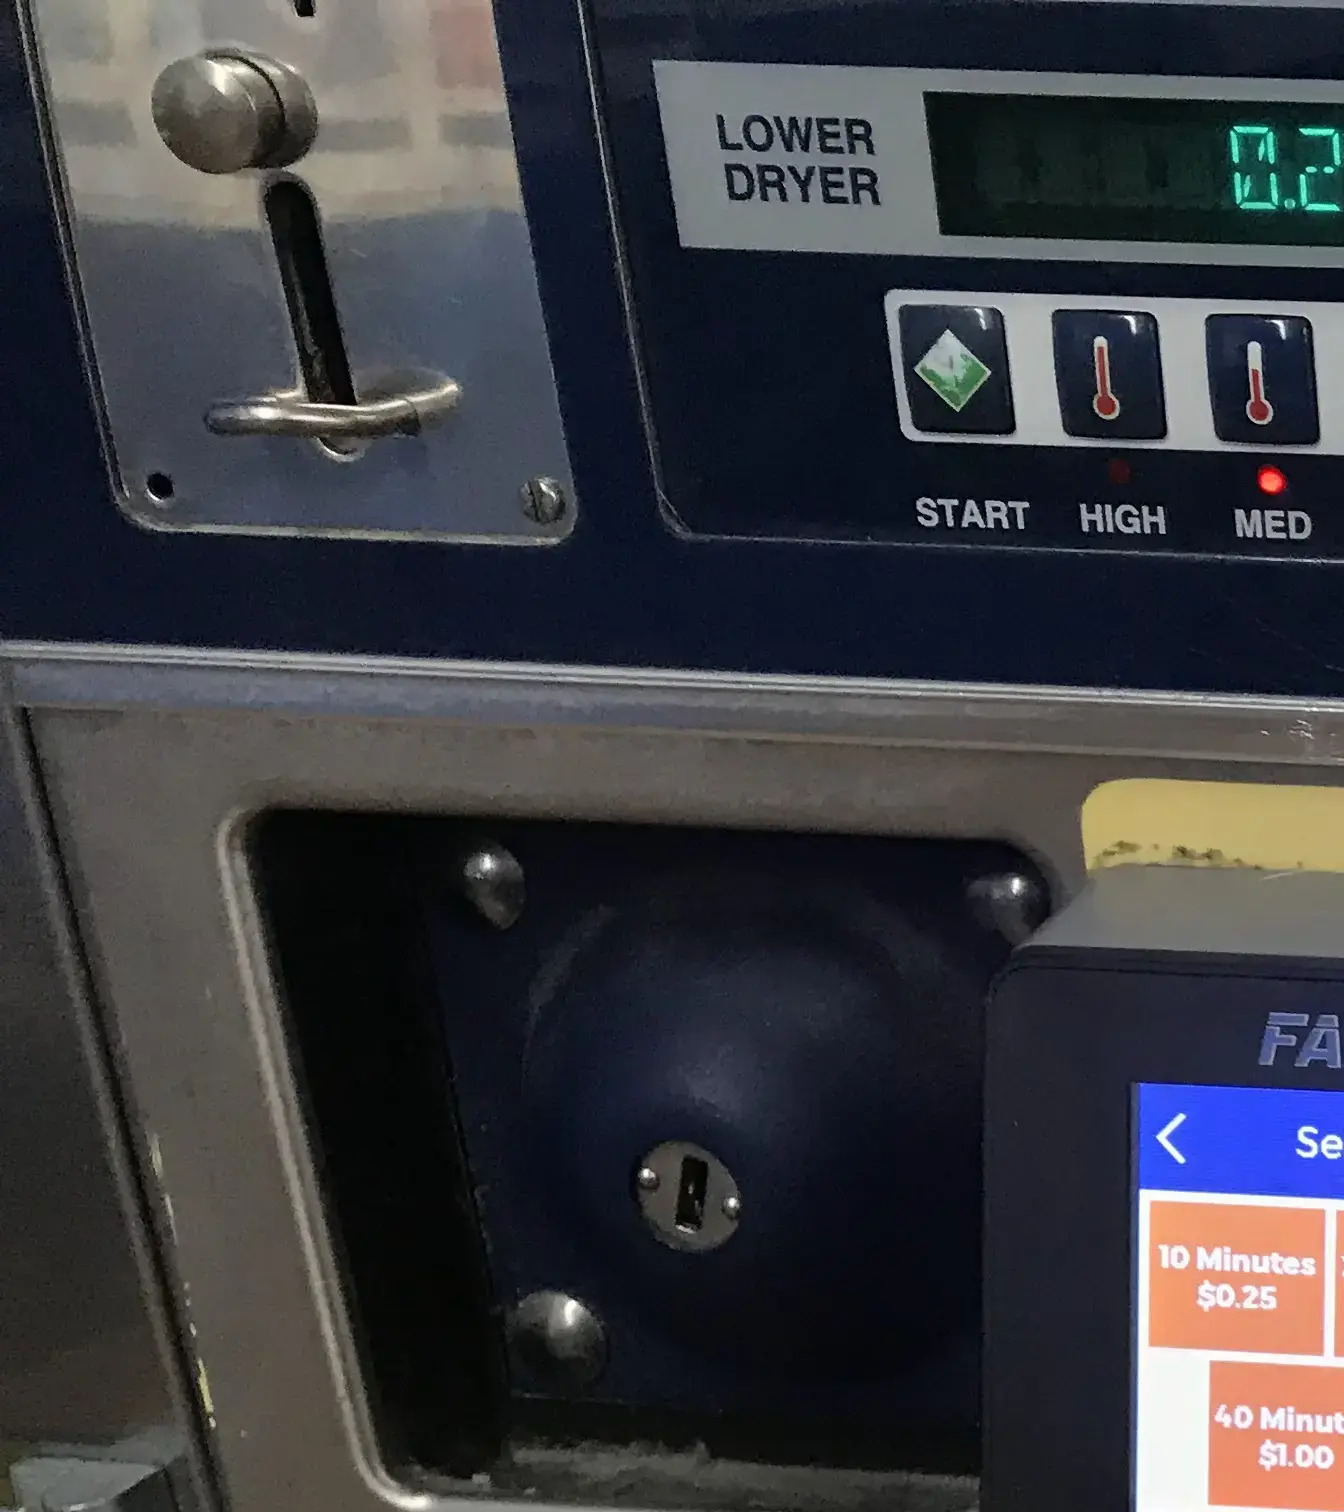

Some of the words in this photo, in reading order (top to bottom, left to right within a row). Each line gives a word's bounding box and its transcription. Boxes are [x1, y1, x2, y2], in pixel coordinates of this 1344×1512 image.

[715, 114, 876, 157] LOWER
[724, 163, 881, 207] DRYER
[915, 497, 1030, 533] START
[1079, 502, 1167, 537] HIGH
[1233, 507, 1313, 541] MED
[1158, 1245, 1190, 1273] 10
[1196, 1247, 1317, 1279] Minutes
[1197, 1281, 1278, 1314] $0.25
[1213, 1404, 1254, 1432] 40
[1258, 1440, 1336, 1472] $1.00
